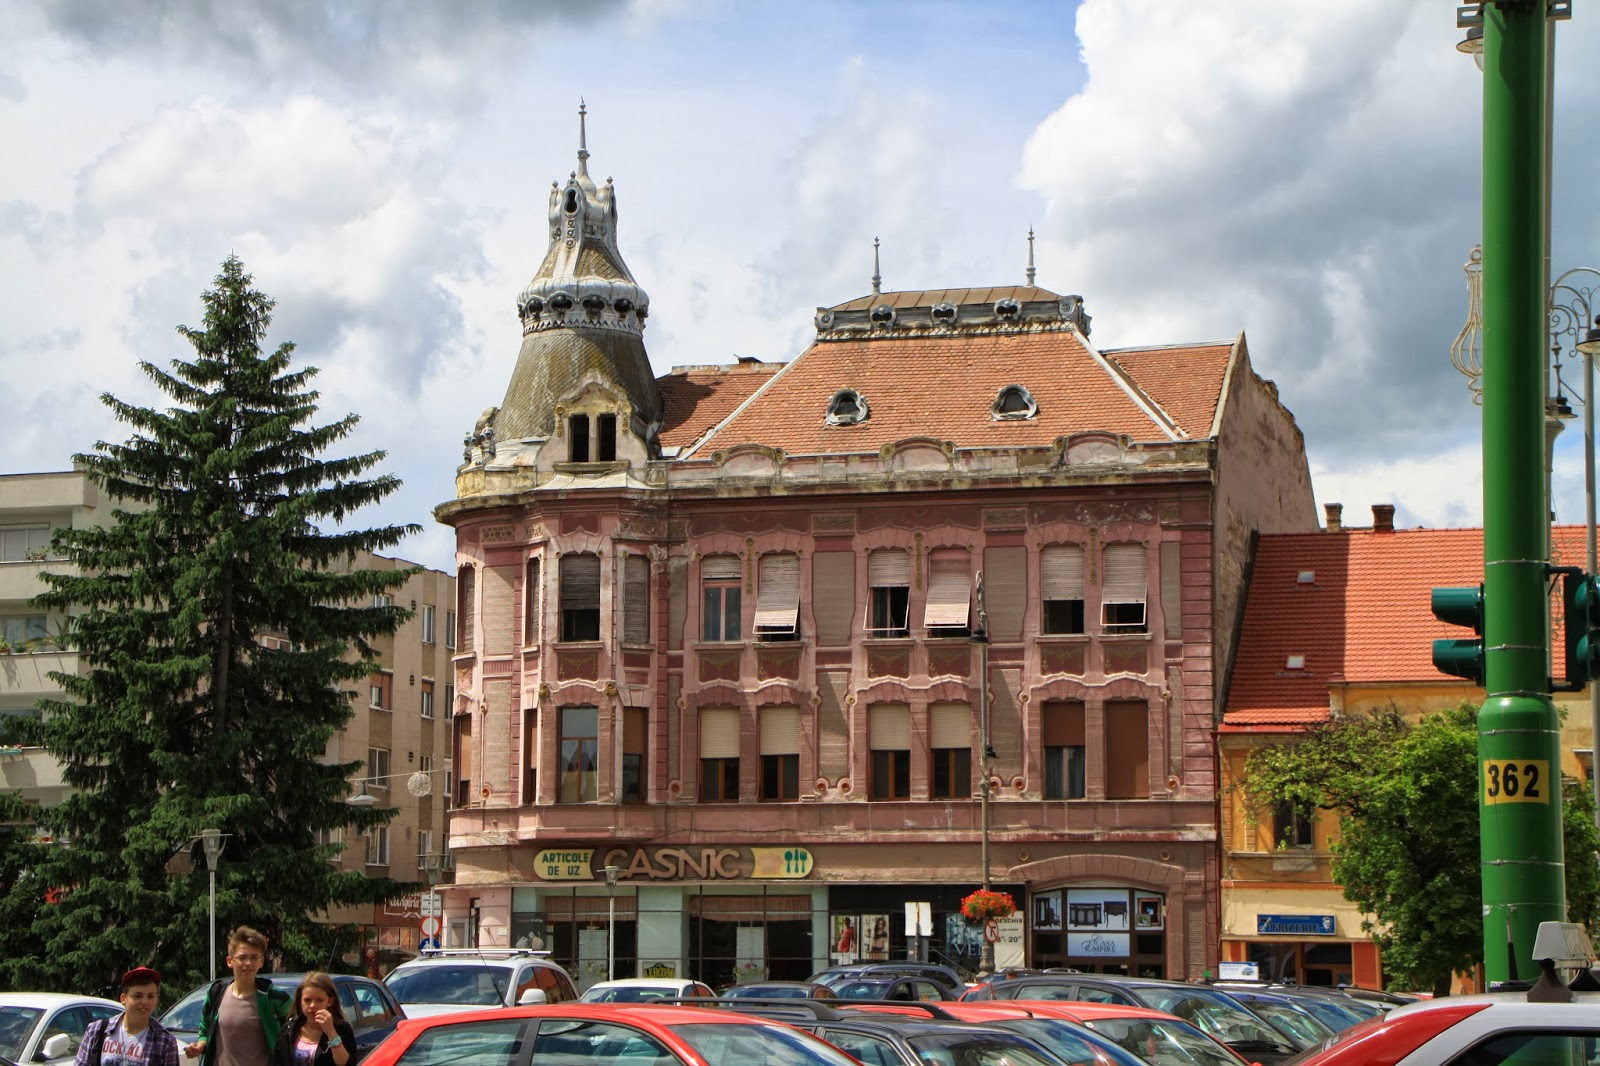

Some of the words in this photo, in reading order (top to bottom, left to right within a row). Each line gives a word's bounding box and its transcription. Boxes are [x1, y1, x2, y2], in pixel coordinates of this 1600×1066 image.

[1487, 763, 1540, 798] 362
[542, 853, 589, 863] ARTICOLE
[603, 848, 740, 879] CASNIC
[548, 866, 560, 876] DE
[568, 866, 581, 876] UZ
